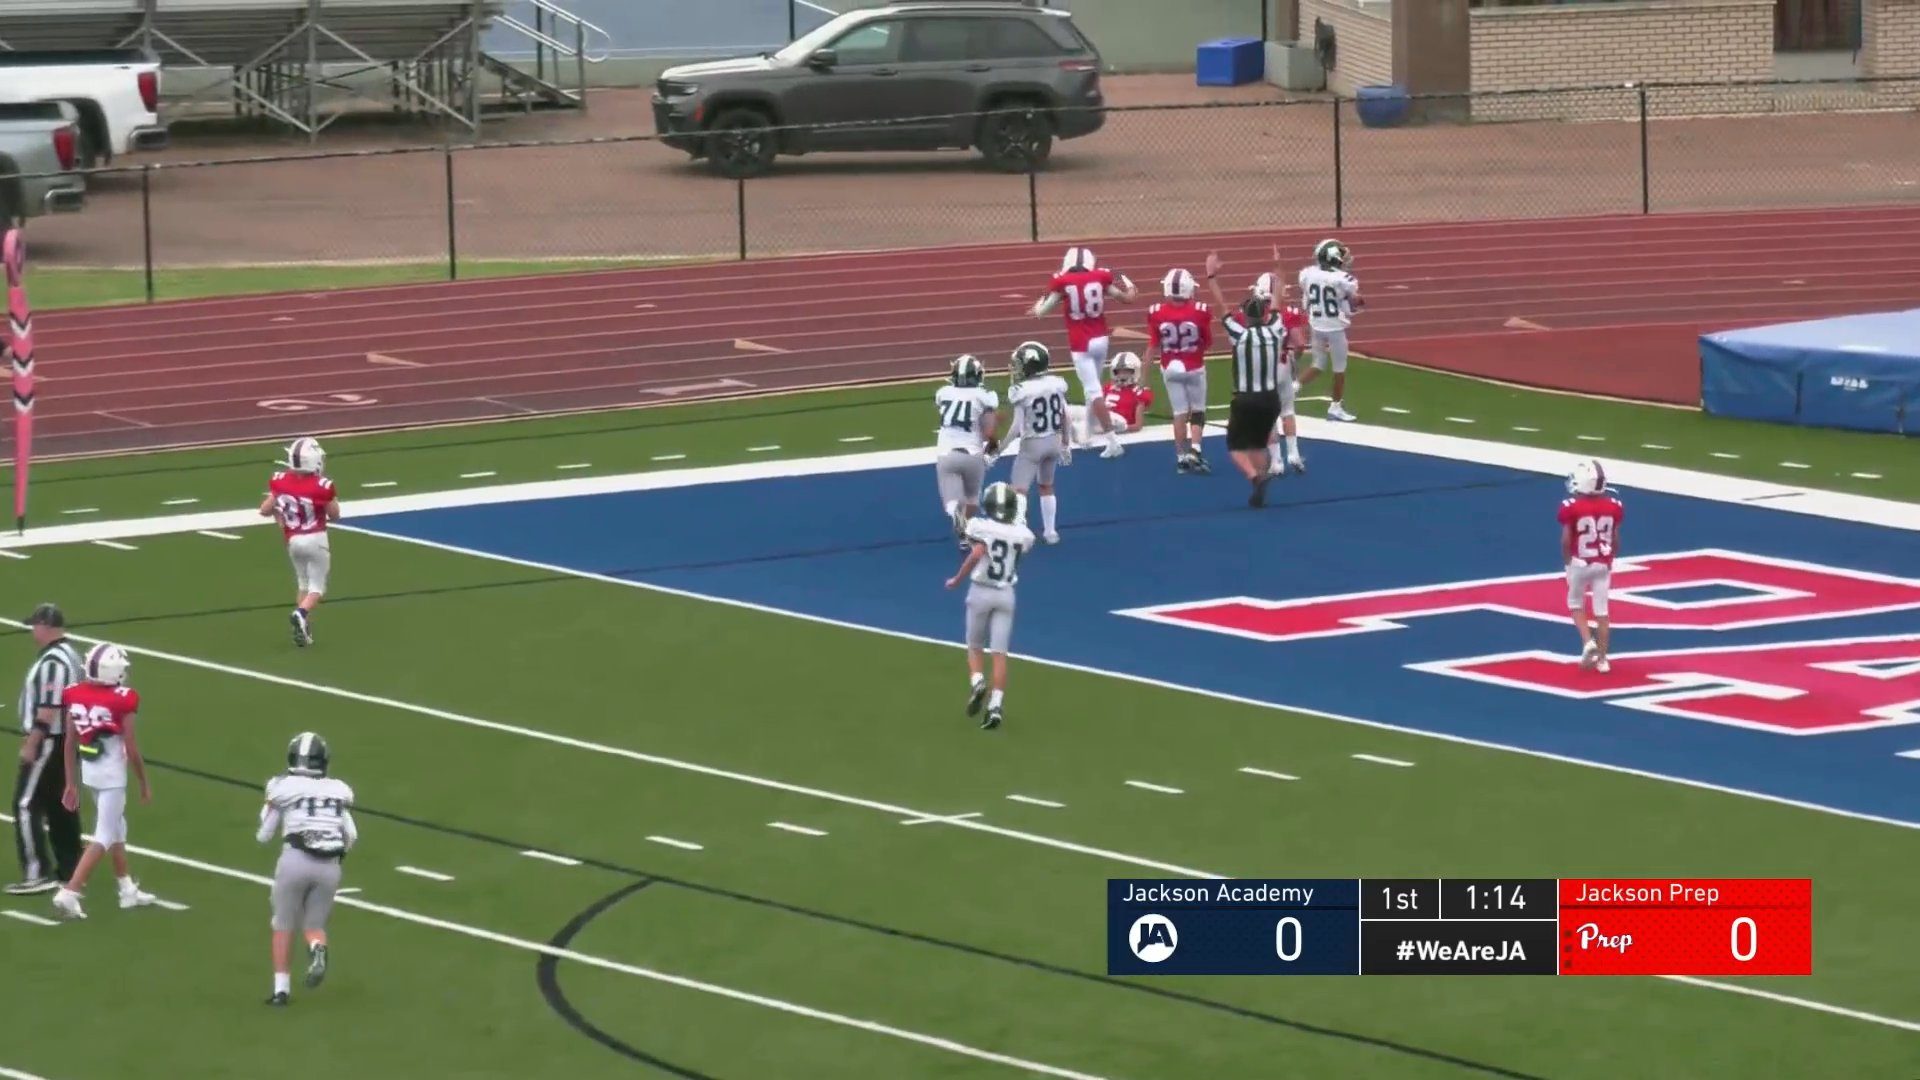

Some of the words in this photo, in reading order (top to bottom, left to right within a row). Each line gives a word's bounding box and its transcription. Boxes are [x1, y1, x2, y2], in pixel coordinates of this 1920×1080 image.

[1065, 281, 1103, 320] 18
[1309, 283, 1340, 318] 26
[1159, 321, 1199, 353] 22
[941, 400, 972, 432] 74
[1031, 393, 1061, 433] 38
